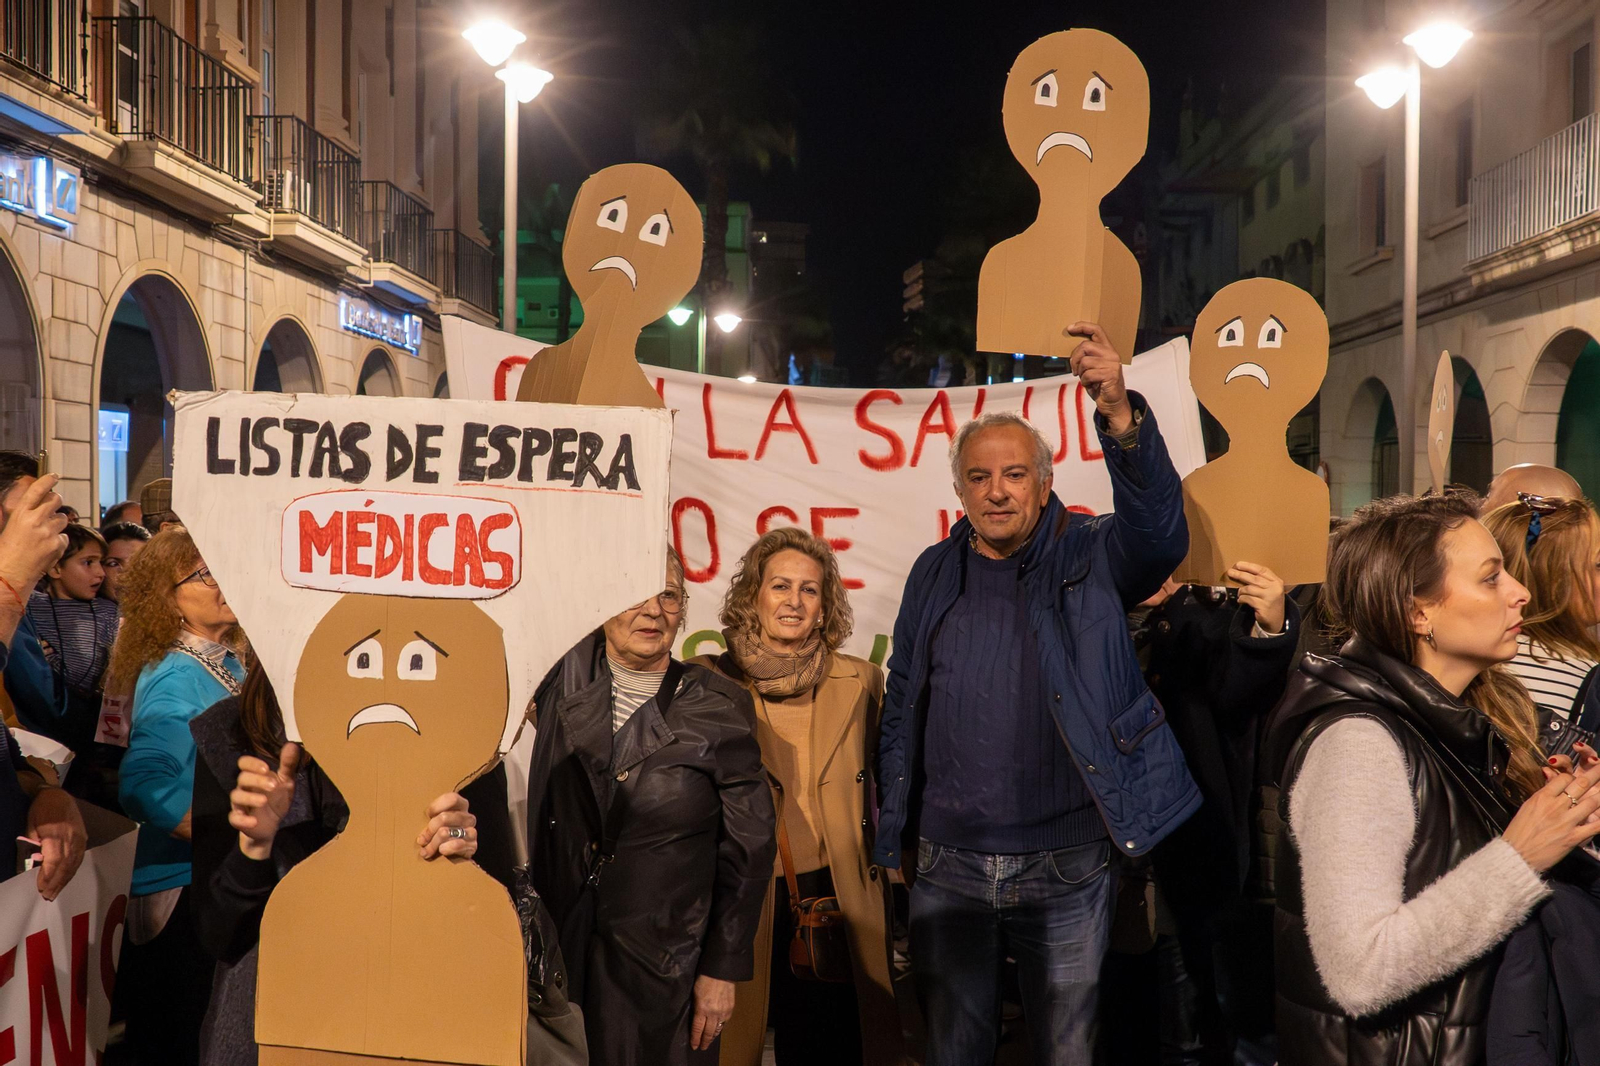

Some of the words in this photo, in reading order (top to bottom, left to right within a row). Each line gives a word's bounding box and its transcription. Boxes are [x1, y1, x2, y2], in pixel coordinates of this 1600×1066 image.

[206, 416, 371, 484] LISTAS
[385, 423, 444, 484] DE
[458, 421, 641, 491] ESPERA
[702, 382, 819, 464] LA
[298, 499, 514, 590] MÉDICAS
